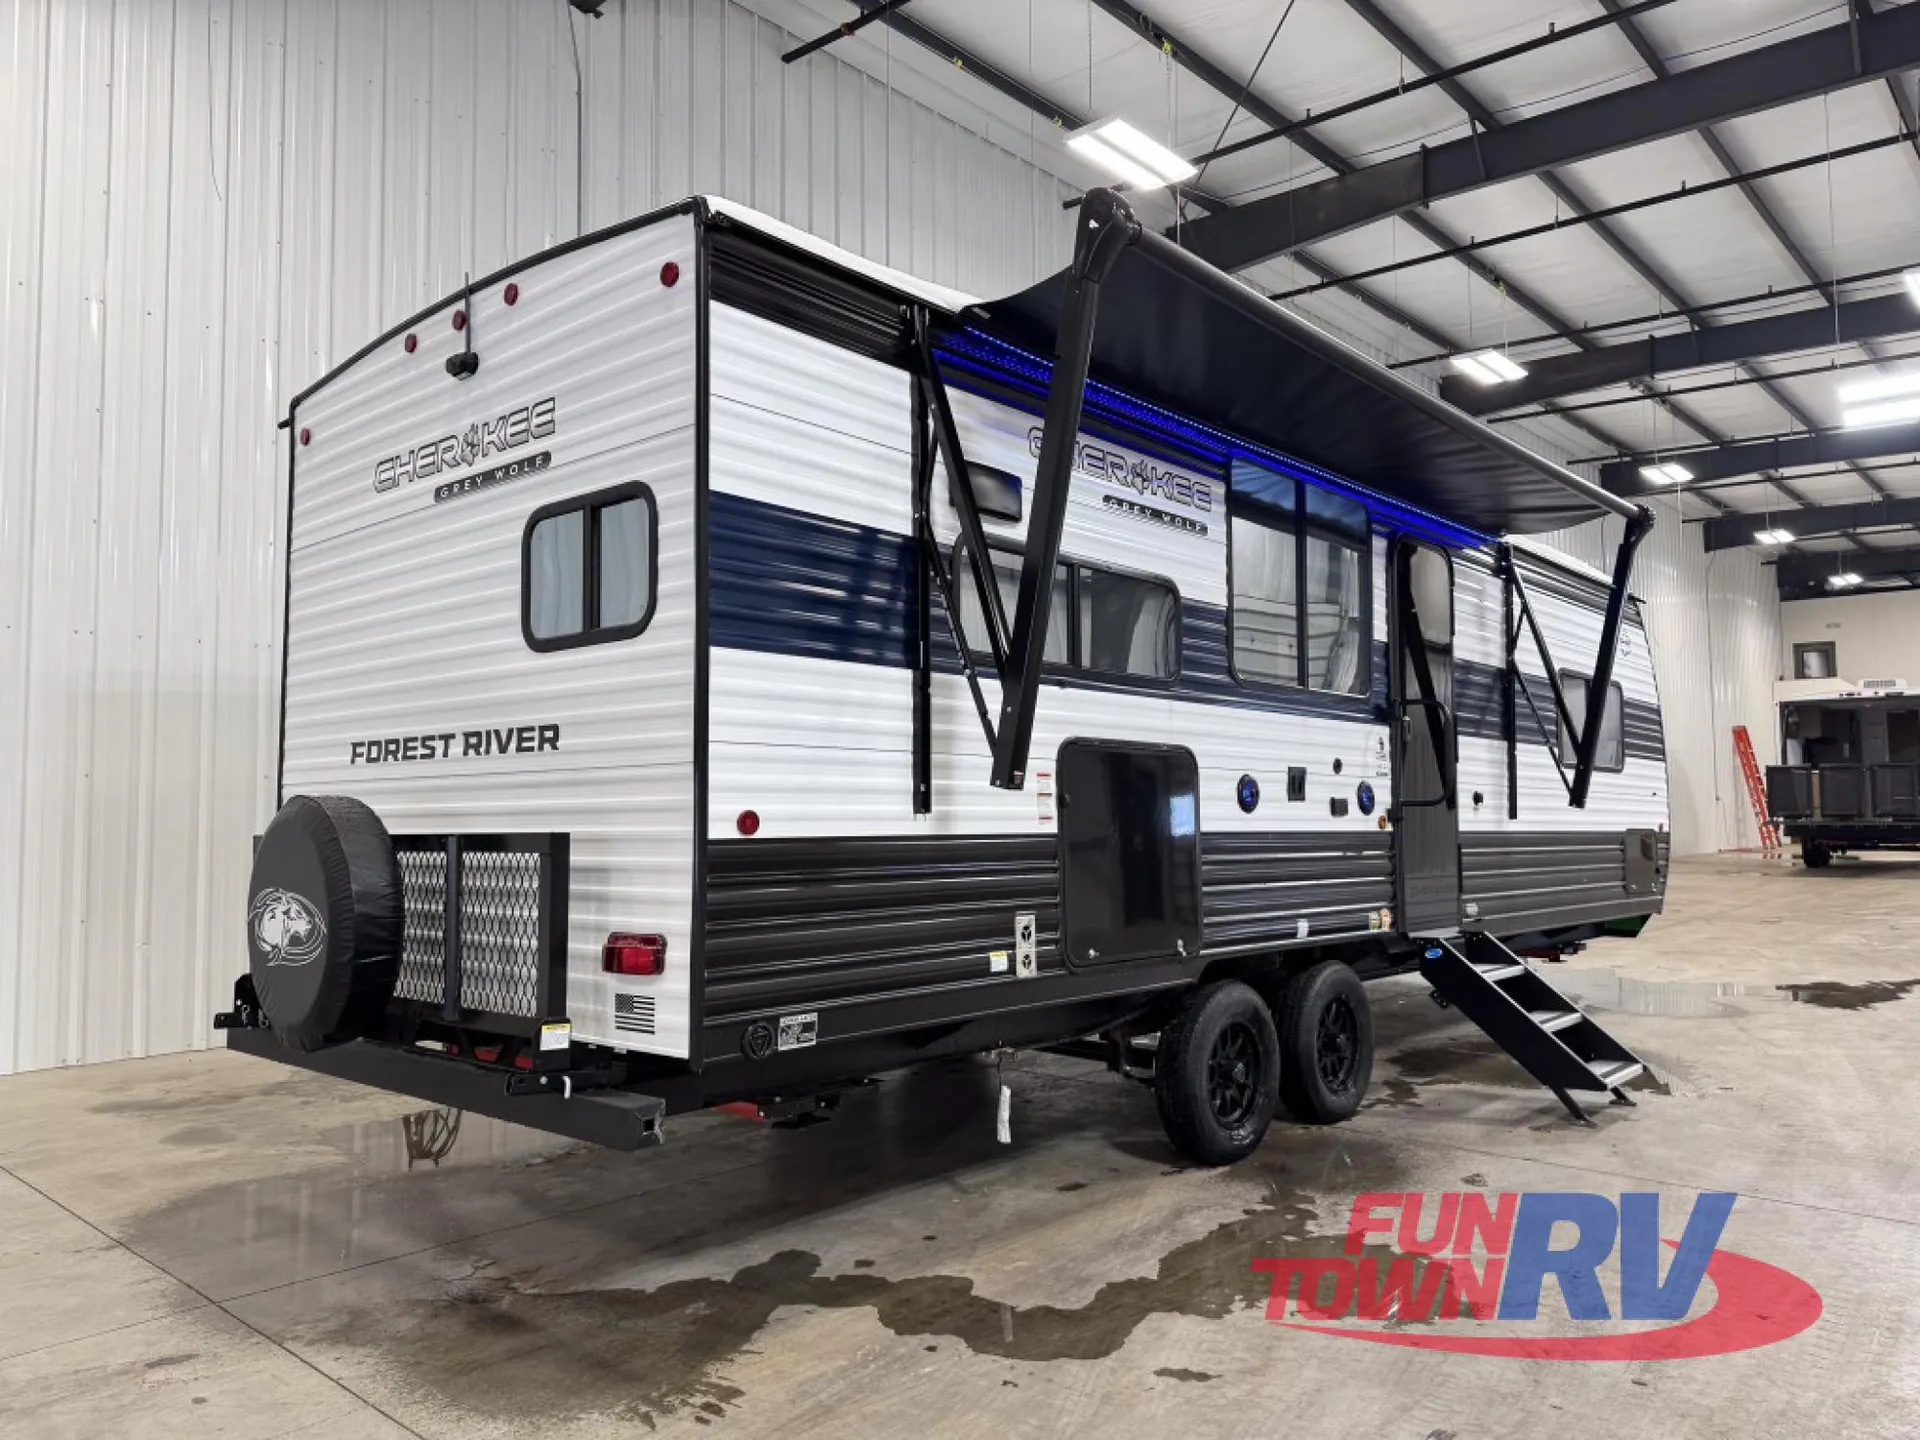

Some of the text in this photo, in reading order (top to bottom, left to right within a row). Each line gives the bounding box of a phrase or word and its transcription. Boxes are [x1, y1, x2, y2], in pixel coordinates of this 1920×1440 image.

[373, 396, 556, 494] CHEROKEE
[440, 455, 544, 498] GREY WOLF
[1162, 513, 1202, 533] WOLF
[350, 723, 560, 765] FOREST RIVER
